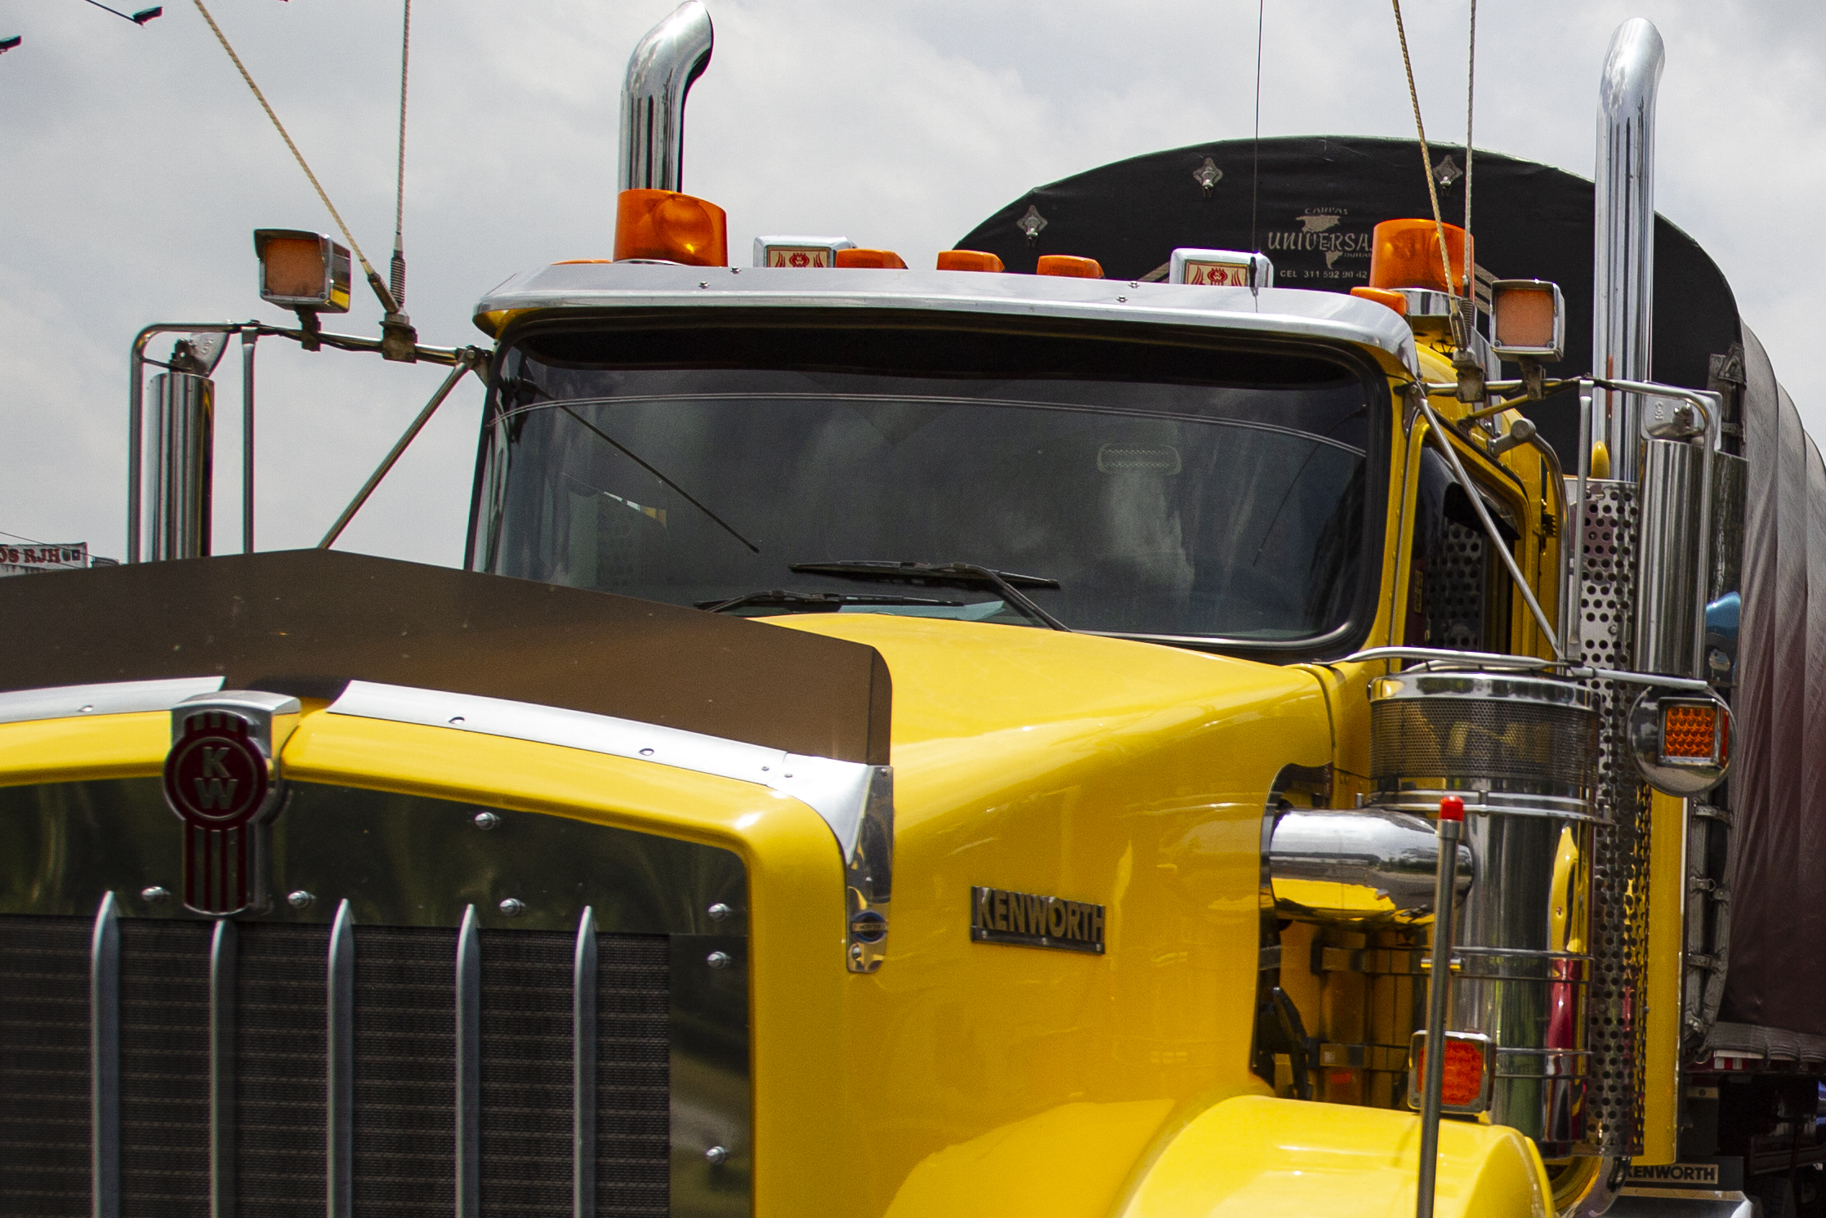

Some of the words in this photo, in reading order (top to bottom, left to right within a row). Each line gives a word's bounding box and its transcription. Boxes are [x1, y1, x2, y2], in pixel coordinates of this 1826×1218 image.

[1304, 207, 1349, 215] CARPAS
[1267, 231, 1372, 251] UNIVERSA
[1280, 269, 1298, 278] CEL
[1303, 270, 1320, 278] 311
[24, 549, 60, 564] RJH
[976, 885, 1106, 942] KENWORTH
